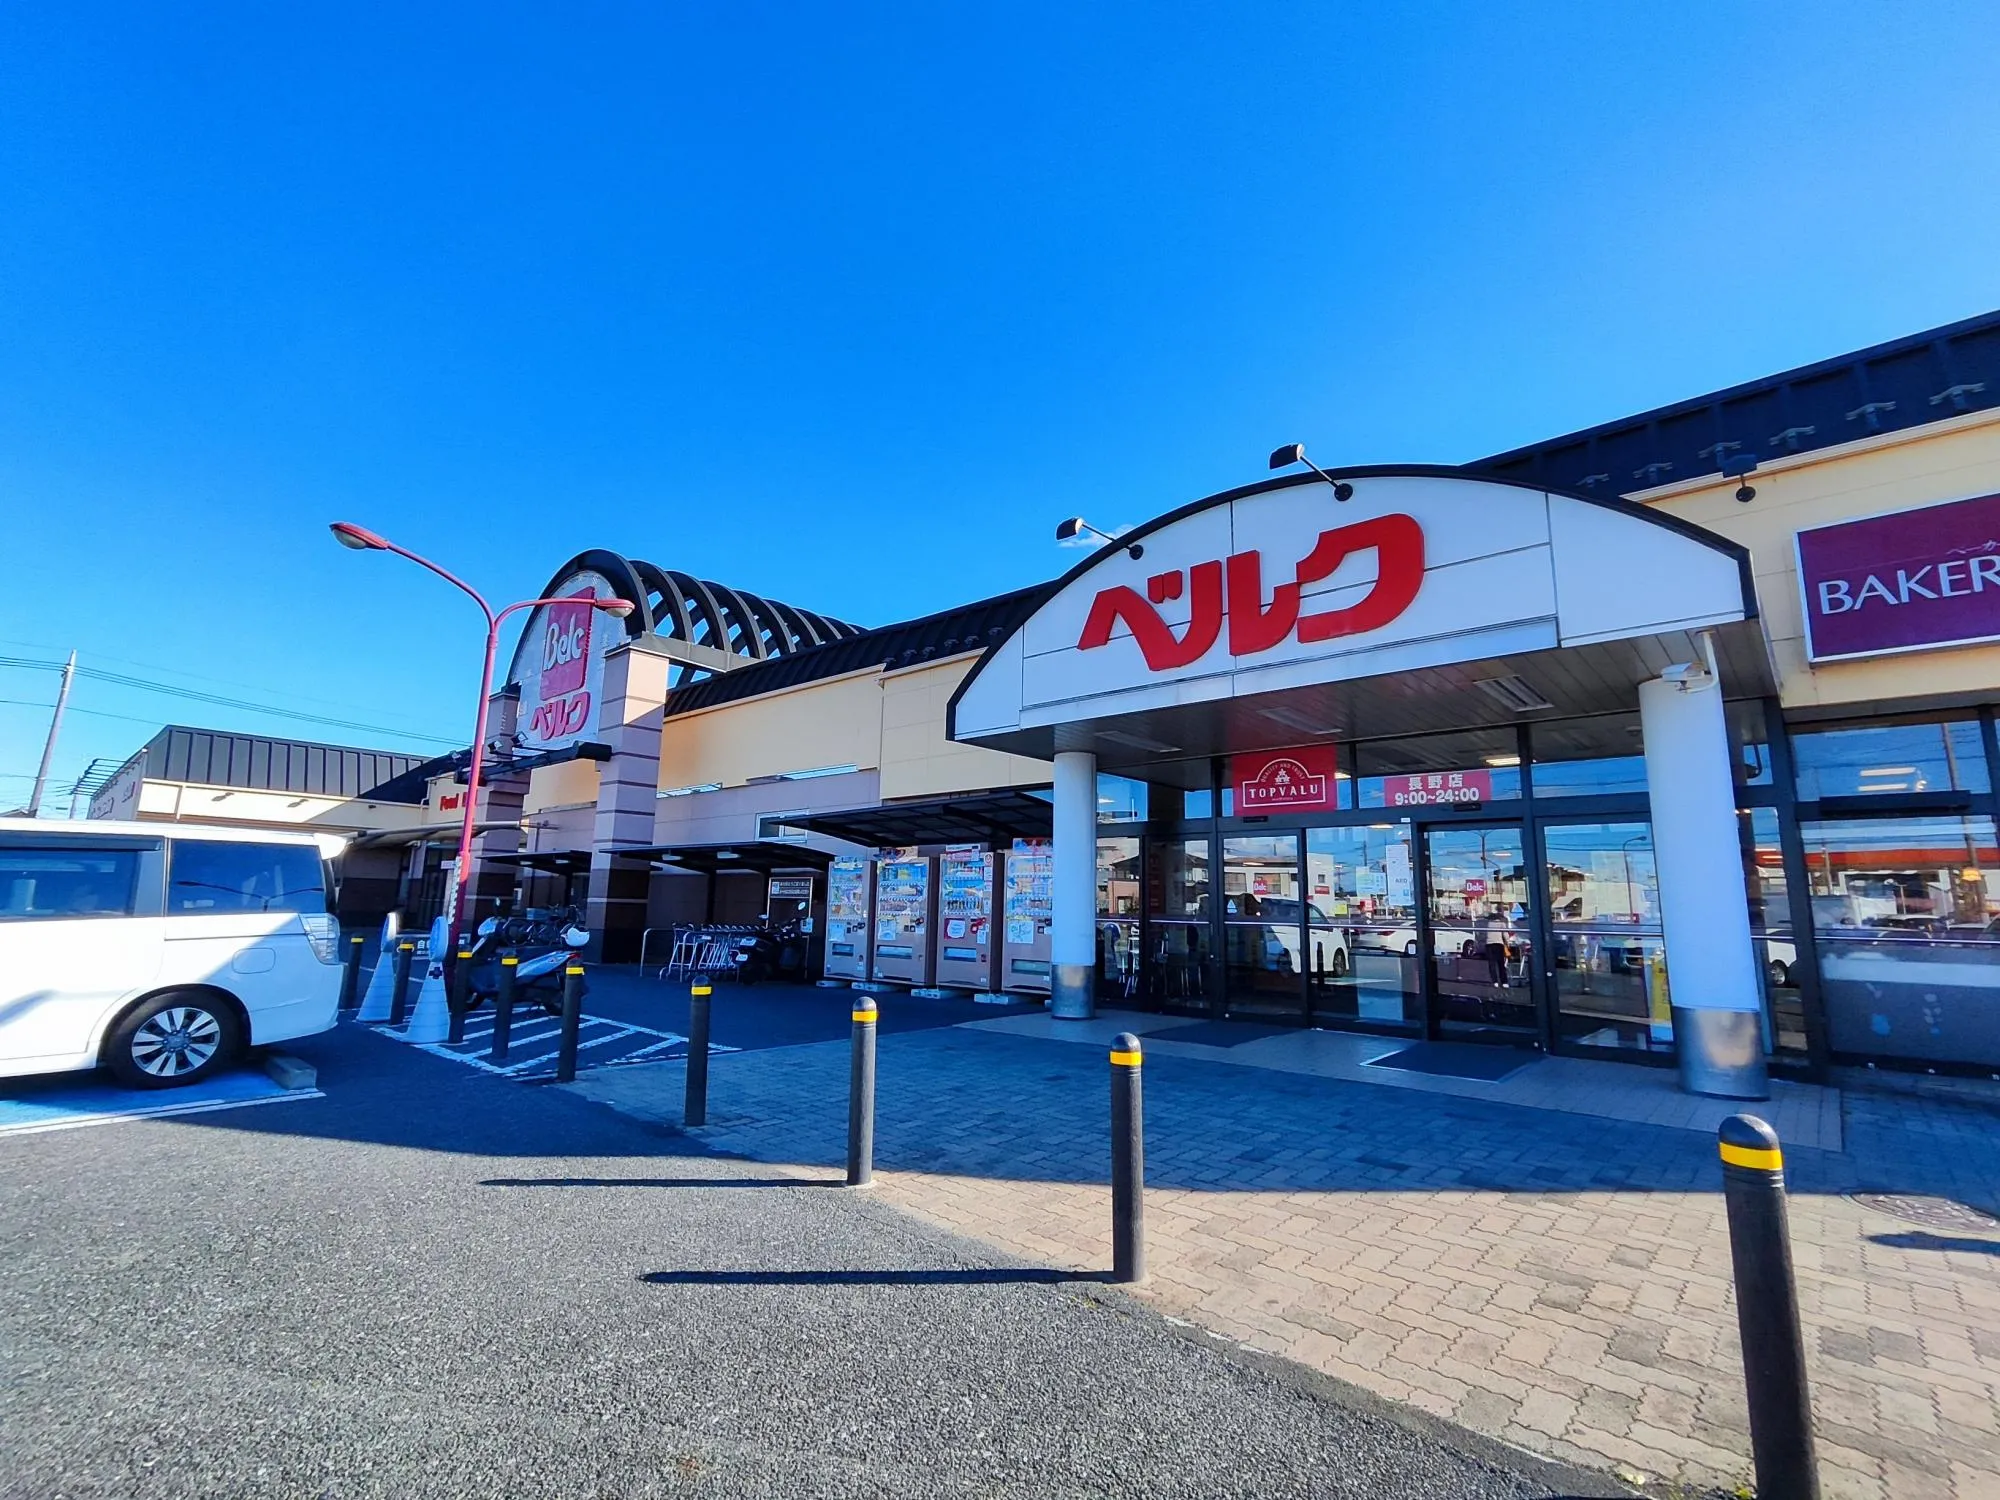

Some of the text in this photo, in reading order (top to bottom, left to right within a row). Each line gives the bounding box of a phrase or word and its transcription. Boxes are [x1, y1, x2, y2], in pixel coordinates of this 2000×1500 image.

[1945, 540, 2000, 555] ベーカ
[1077, 513, 1425, 672] ベルク
[543, 612, 585, 672] Belc
[529, 691, 591, 740] ベルク
[1249, 784, 1318, 799] TOPVALU
[1408, 773, 1463, 791] 長野店
